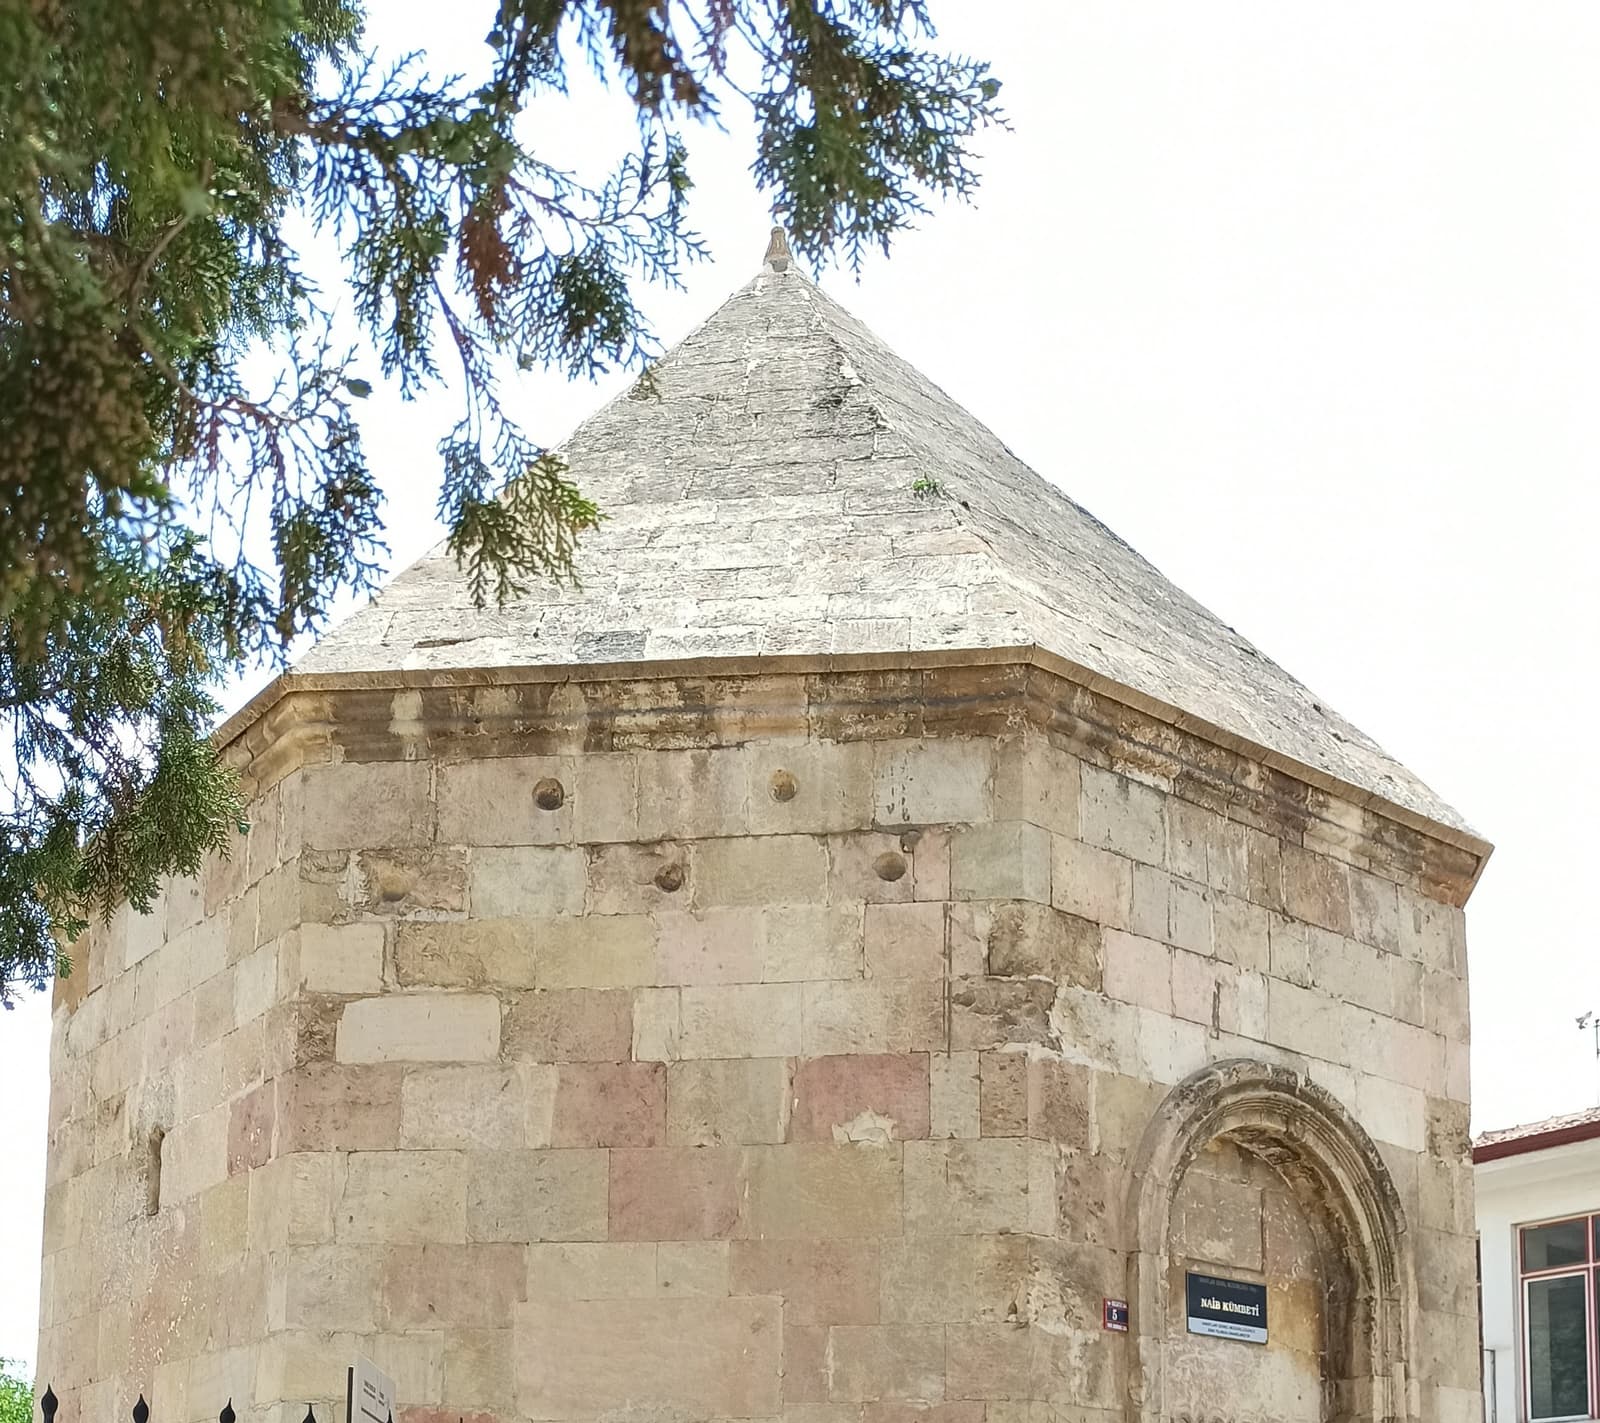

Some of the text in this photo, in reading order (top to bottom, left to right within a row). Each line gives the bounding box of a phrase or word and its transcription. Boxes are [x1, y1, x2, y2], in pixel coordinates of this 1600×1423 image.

[1112, 1308, 1118, 1321] 5
[1201, 1297, 1260, 1317] NAİB KÜMBETİ
